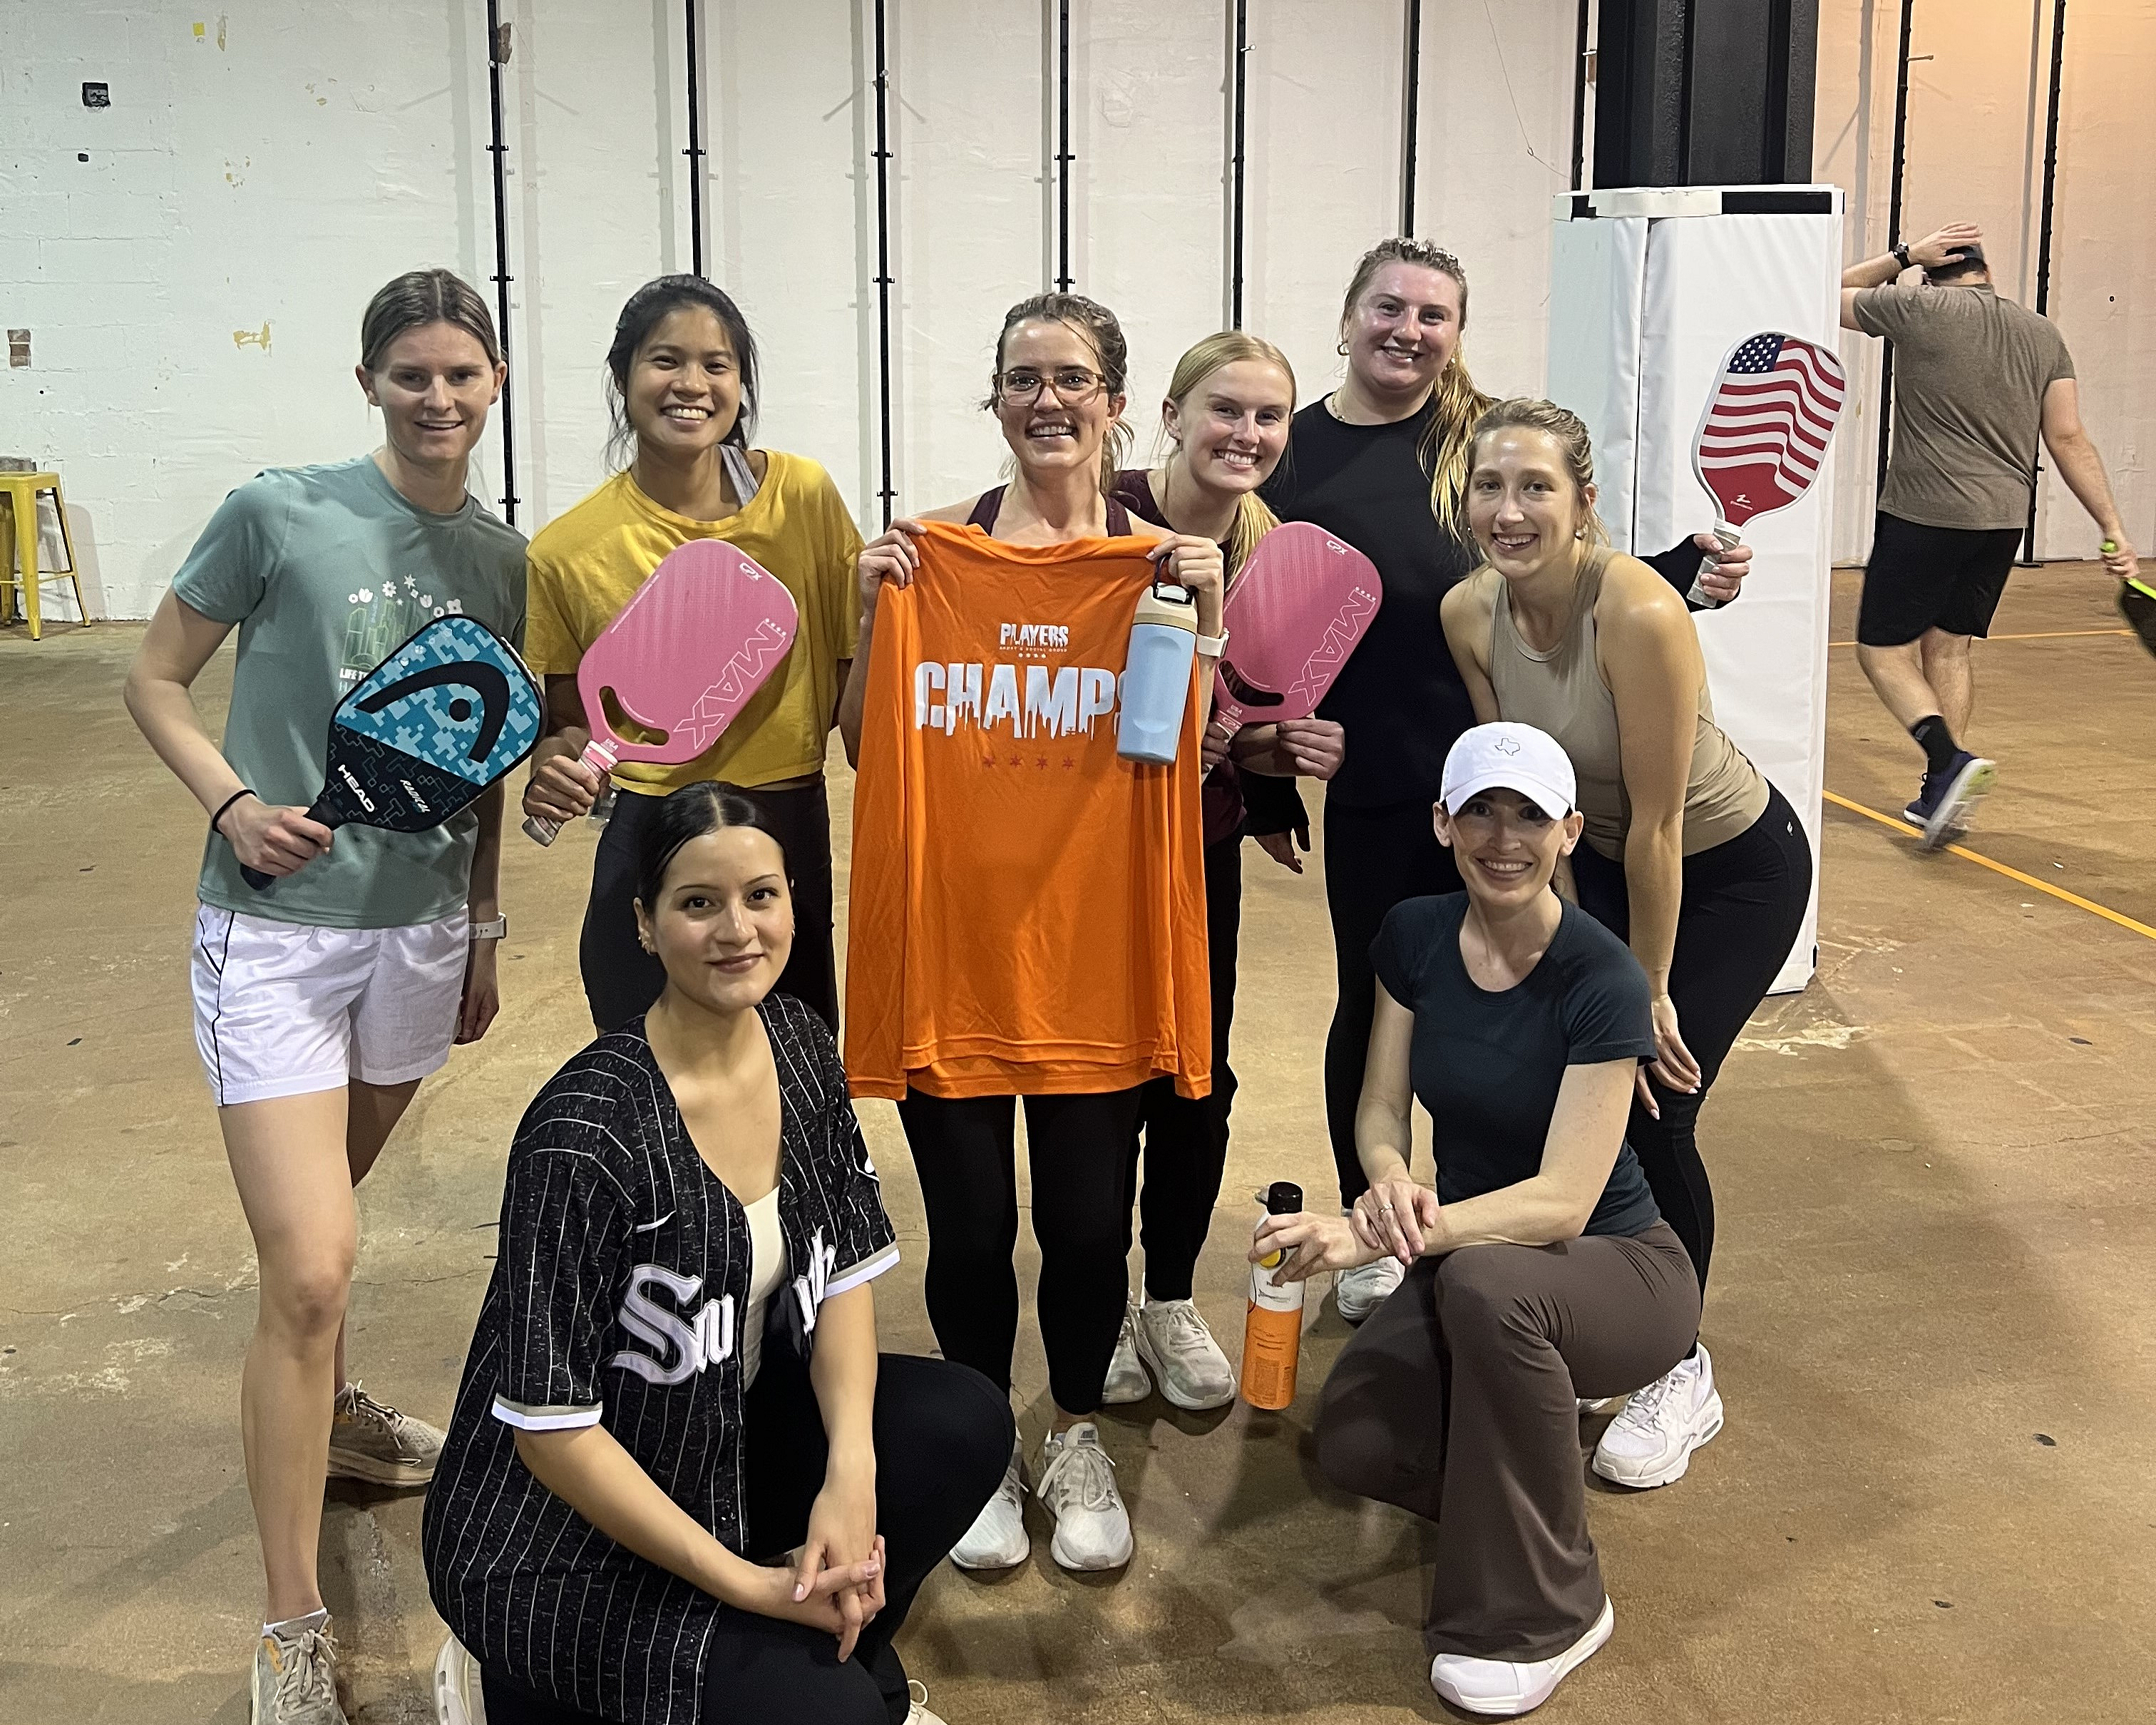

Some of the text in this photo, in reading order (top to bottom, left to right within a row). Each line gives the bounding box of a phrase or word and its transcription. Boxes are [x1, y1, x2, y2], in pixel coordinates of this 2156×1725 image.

[1000, 623, 1069, 647] PLAYERS
[1288, 588, 1376, 707] MAX
[672, 620, 786, 750] MAX
[337, 764, 375, 813] HEAD
